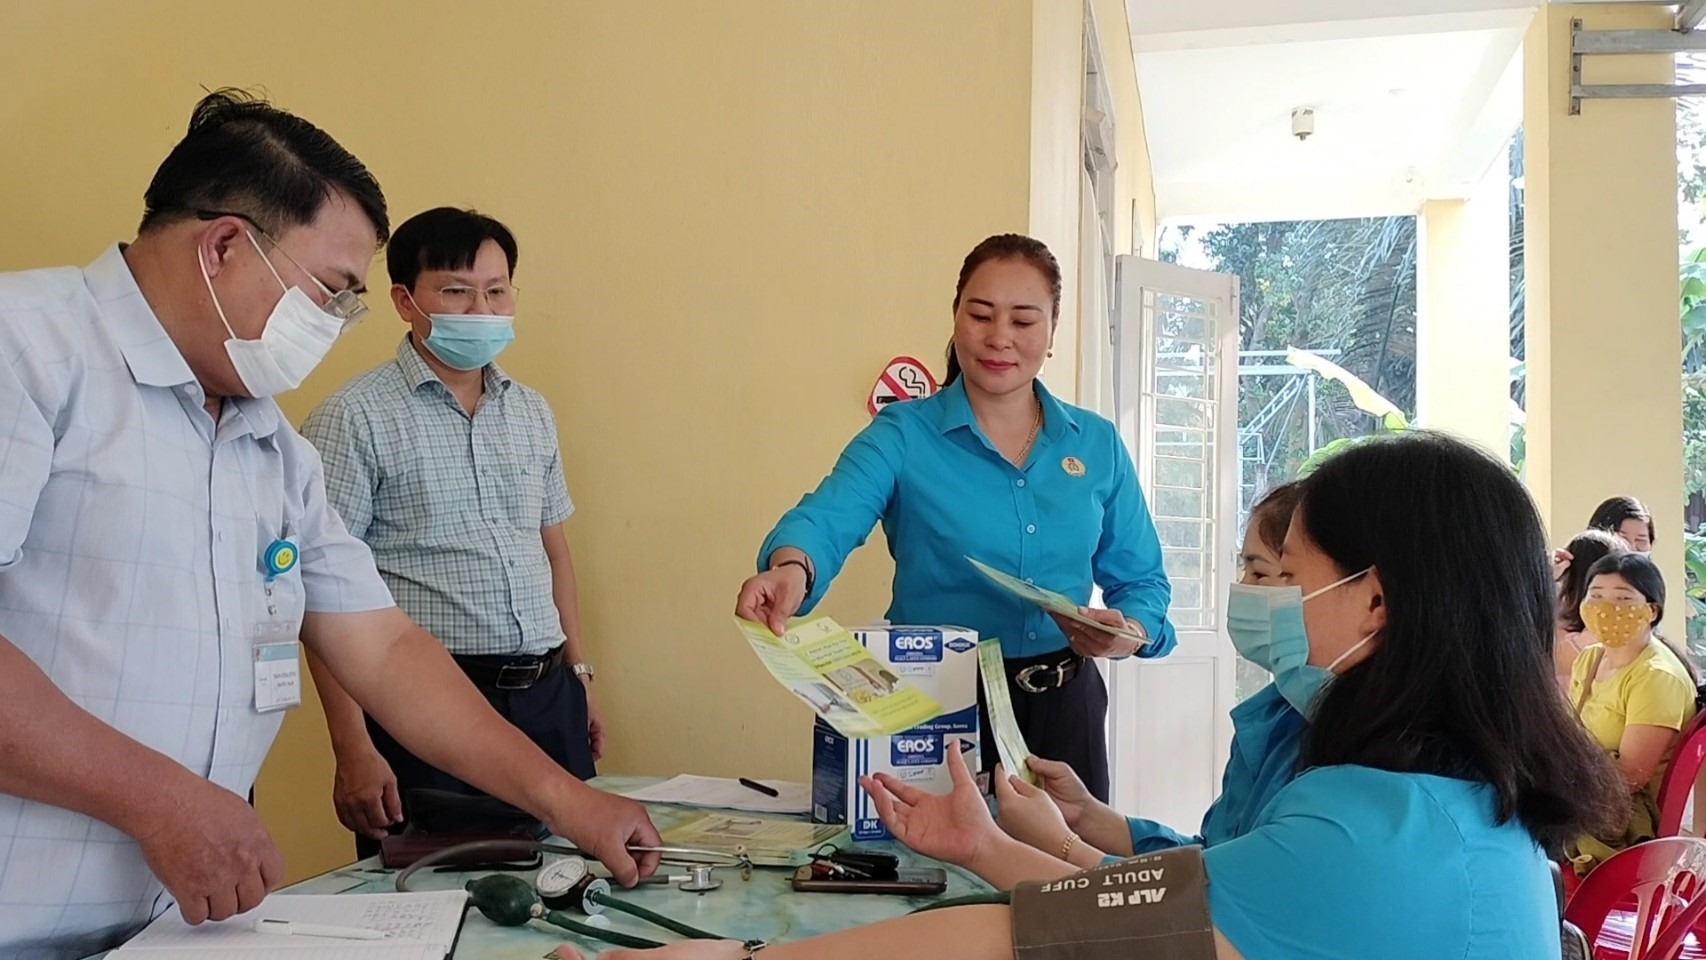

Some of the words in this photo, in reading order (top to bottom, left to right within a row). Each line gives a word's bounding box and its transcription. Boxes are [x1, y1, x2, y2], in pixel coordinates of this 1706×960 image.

[895, 636, 934, 650] EROS
[897, 739, 935, 753] EROS
[863, 820, 878, 830] DK
[1102, 868, 1164, 886] ADULT
[1041, 878, 1090, 893] CUFF
